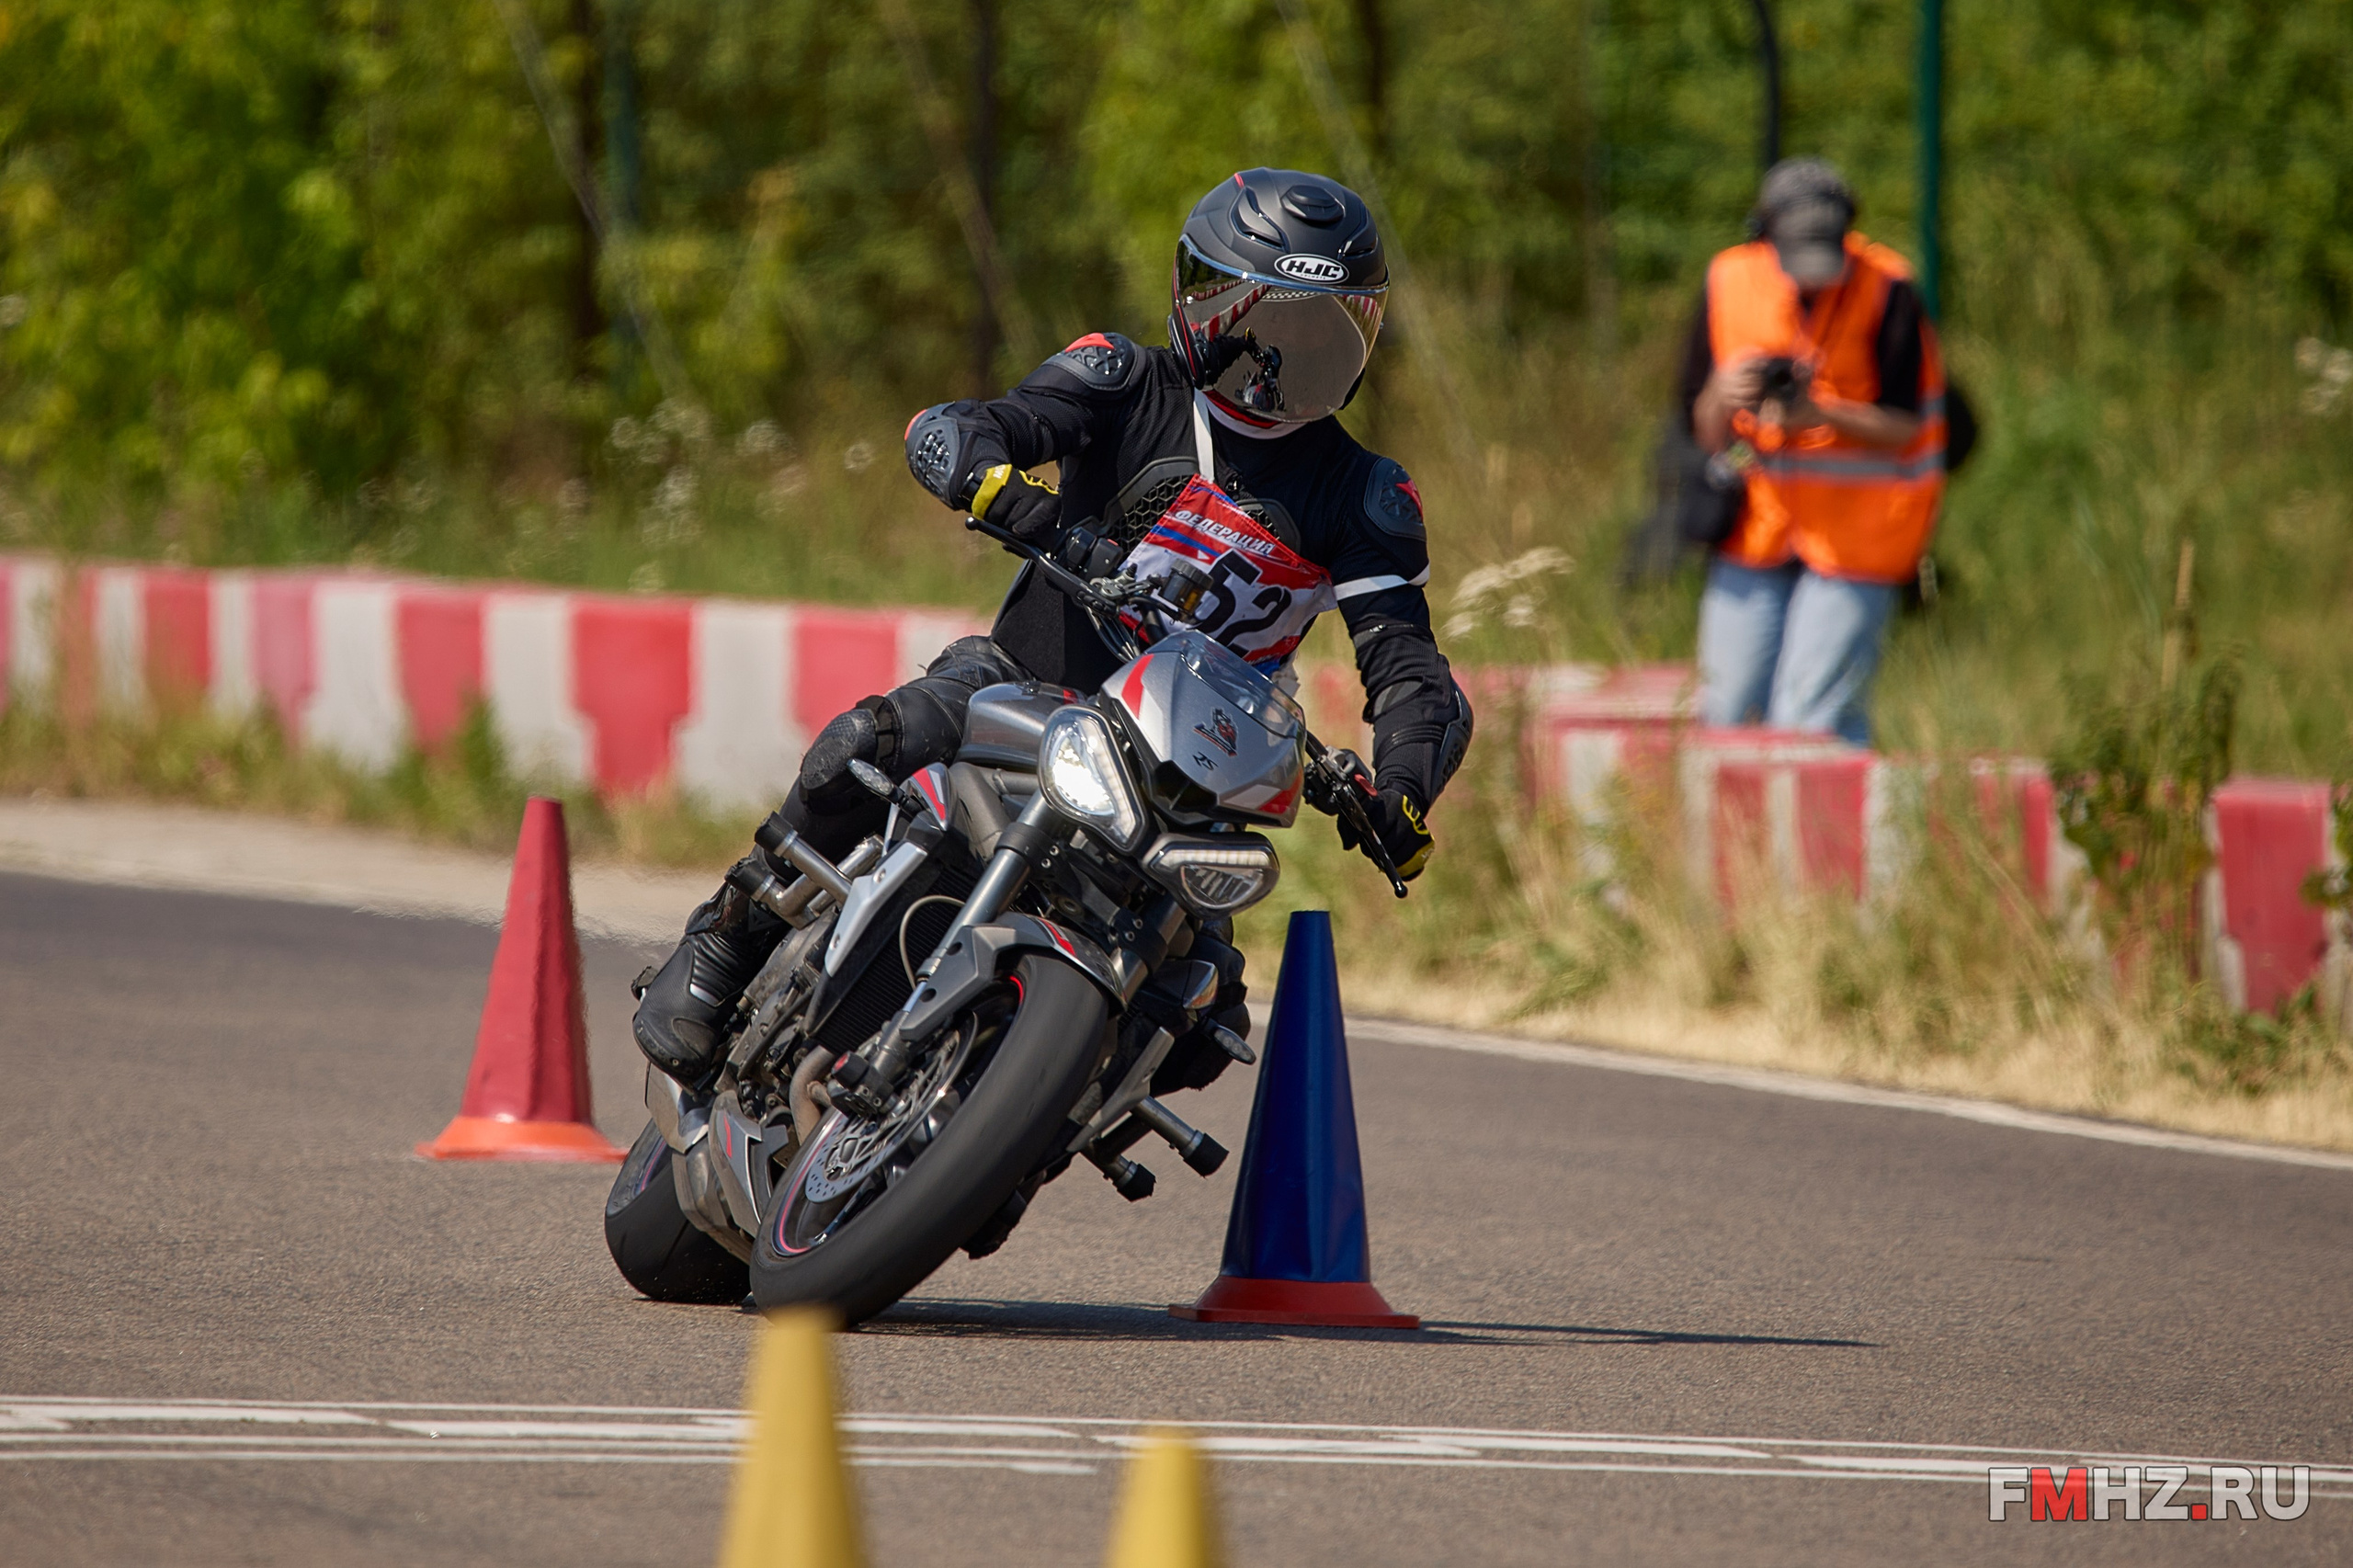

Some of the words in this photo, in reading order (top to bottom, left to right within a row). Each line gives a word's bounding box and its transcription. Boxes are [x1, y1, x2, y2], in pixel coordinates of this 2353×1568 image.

[1286, 260, 1341, 278] HJC
[1175, 510, 1276, 555] ФЕДЕРАЦИЯ
[1194, 551, 1292, 657] 52
